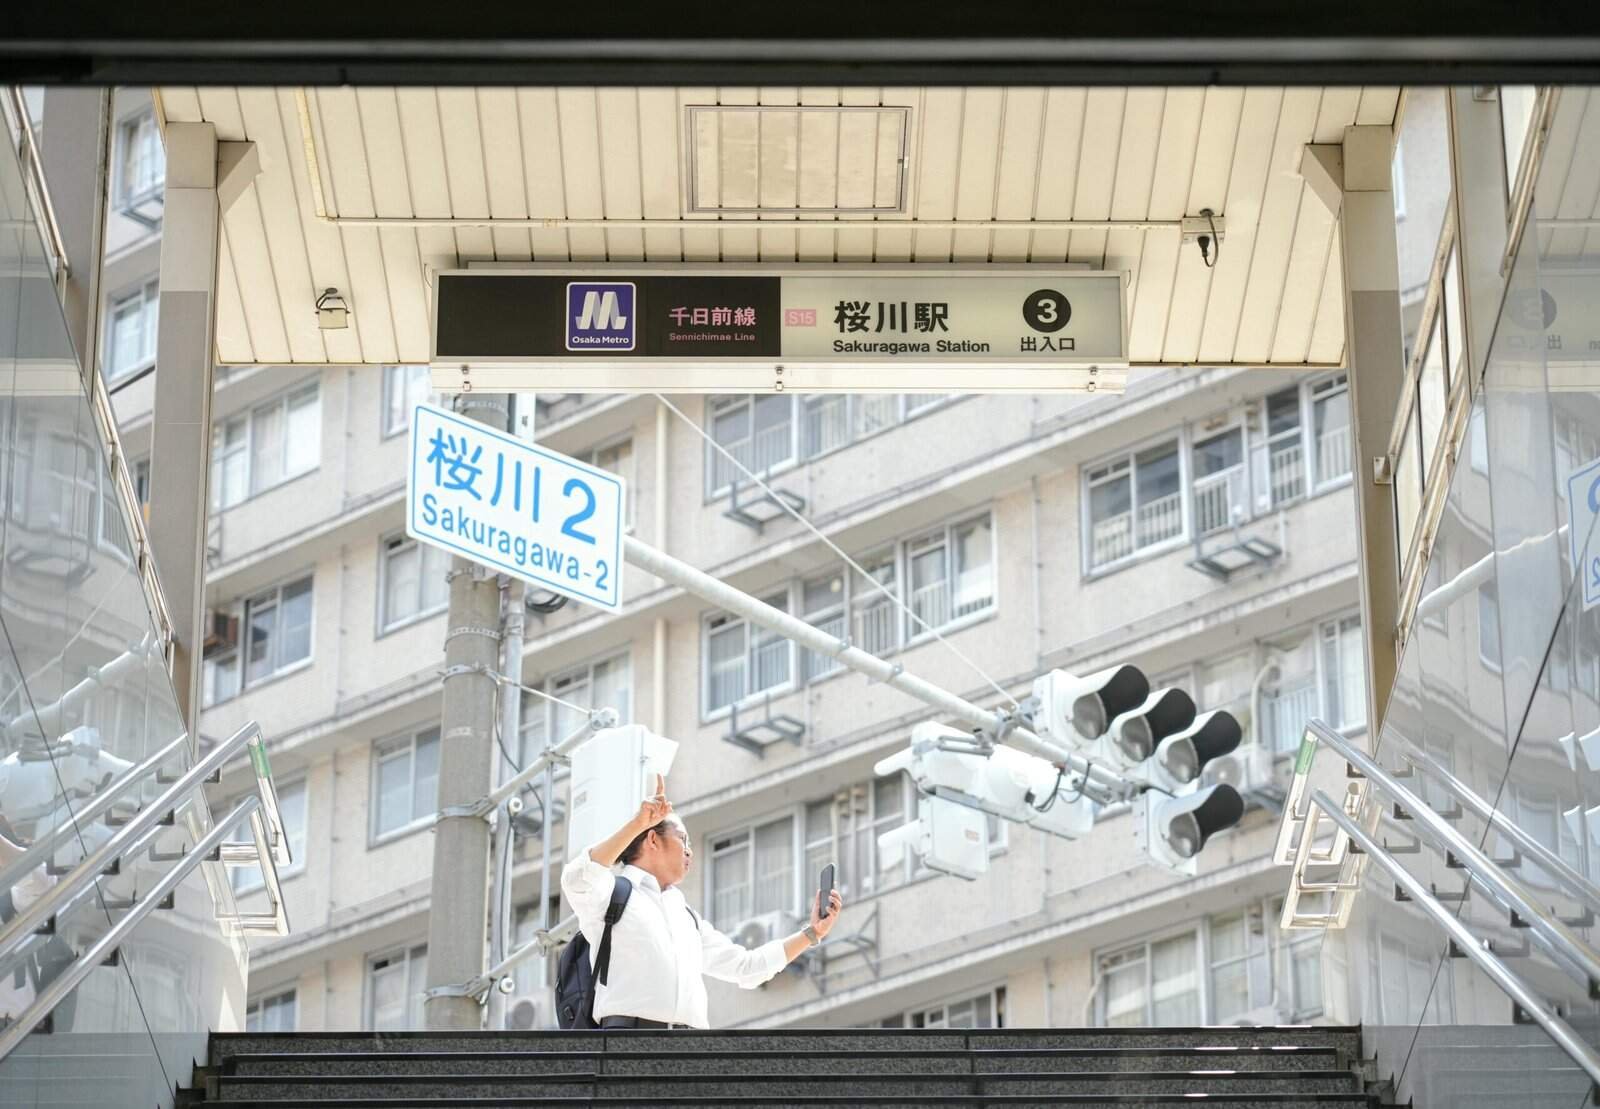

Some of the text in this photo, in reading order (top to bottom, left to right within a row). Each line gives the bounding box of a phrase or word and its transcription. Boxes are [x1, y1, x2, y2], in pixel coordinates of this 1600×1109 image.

[669, 306, 756, 326] 千日前線
[788, 311, 815, 325] S15
[834, 300, 949, 333] 桜川駅
[1036, 299, 1058, 324] 3
[572, 336, 629, 344] Osaka Metro
[669, 332, 755, 341] Sennichimae Line
[1020, 336, 1075, 353] 出入口
[833, 339, 990, 354] Sakuragawa Station
[422, 493, 608, 591] Sakuragawa-2
